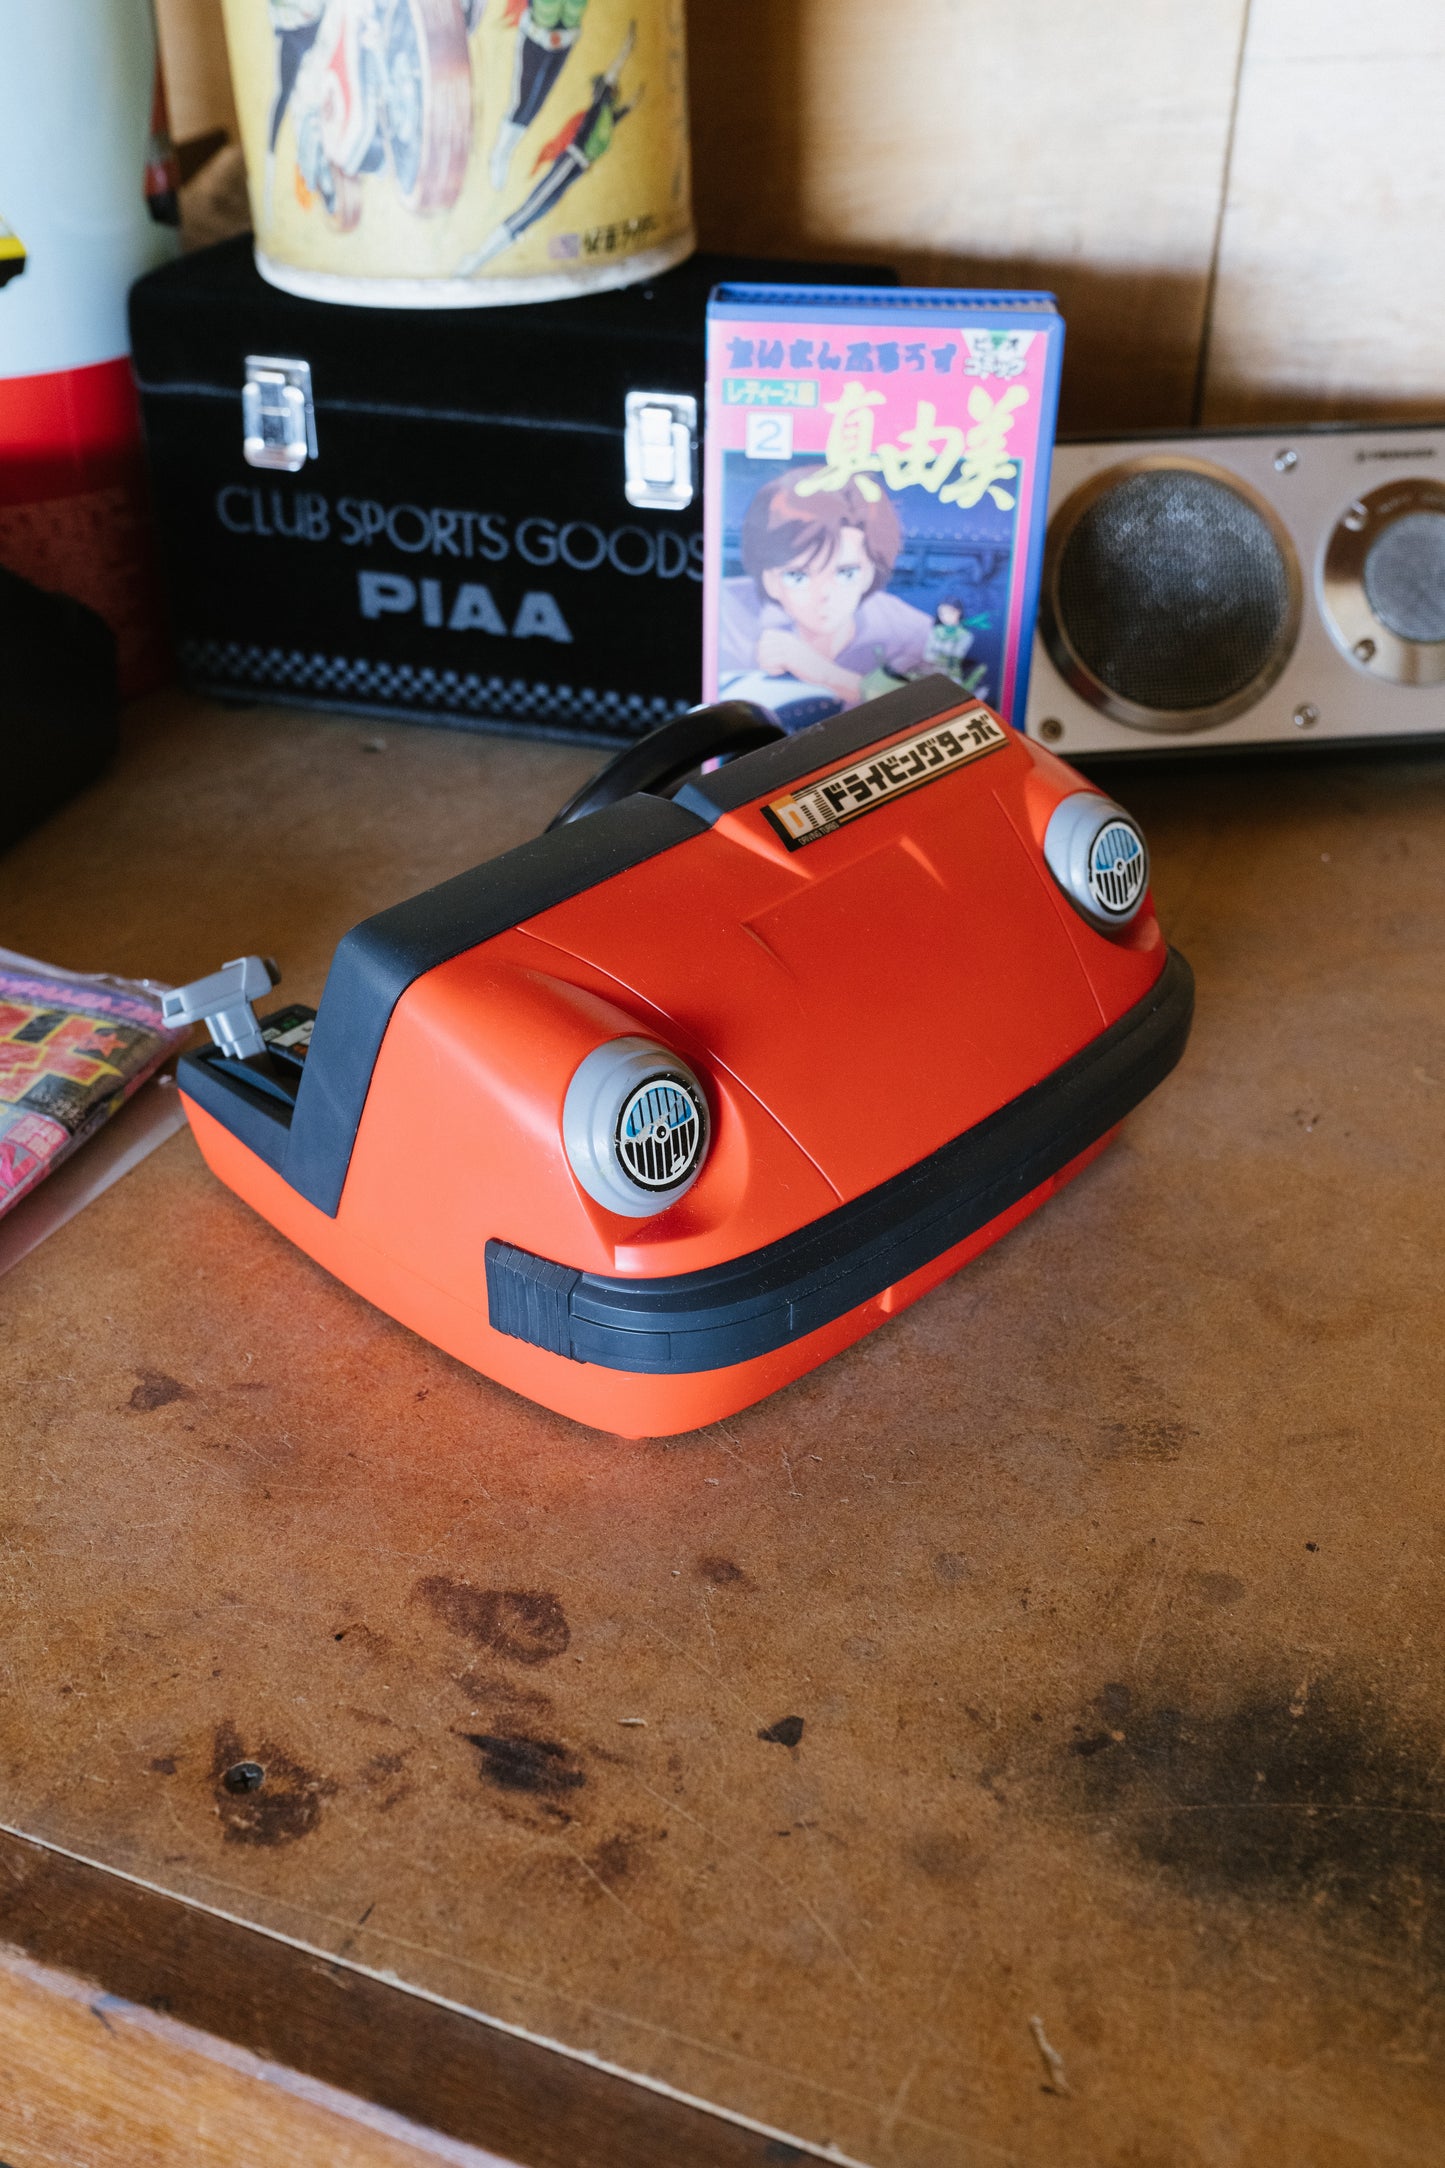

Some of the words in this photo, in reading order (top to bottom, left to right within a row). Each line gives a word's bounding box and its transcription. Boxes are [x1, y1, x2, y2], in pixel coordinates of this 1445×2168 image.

[727, 381, 816, 405] レディース
[755, 420, 783, 452] 2
[794, 381, 1029, 511] 真由美
[215, 485, 330, 541] CLUB
[336, 498, 509, 561] SPORTS
[515, 517, 704, 582] GOODS
[357, 570, 574, 644] PIAA
[822, 714, 1001, 813] ドライビングターボ
